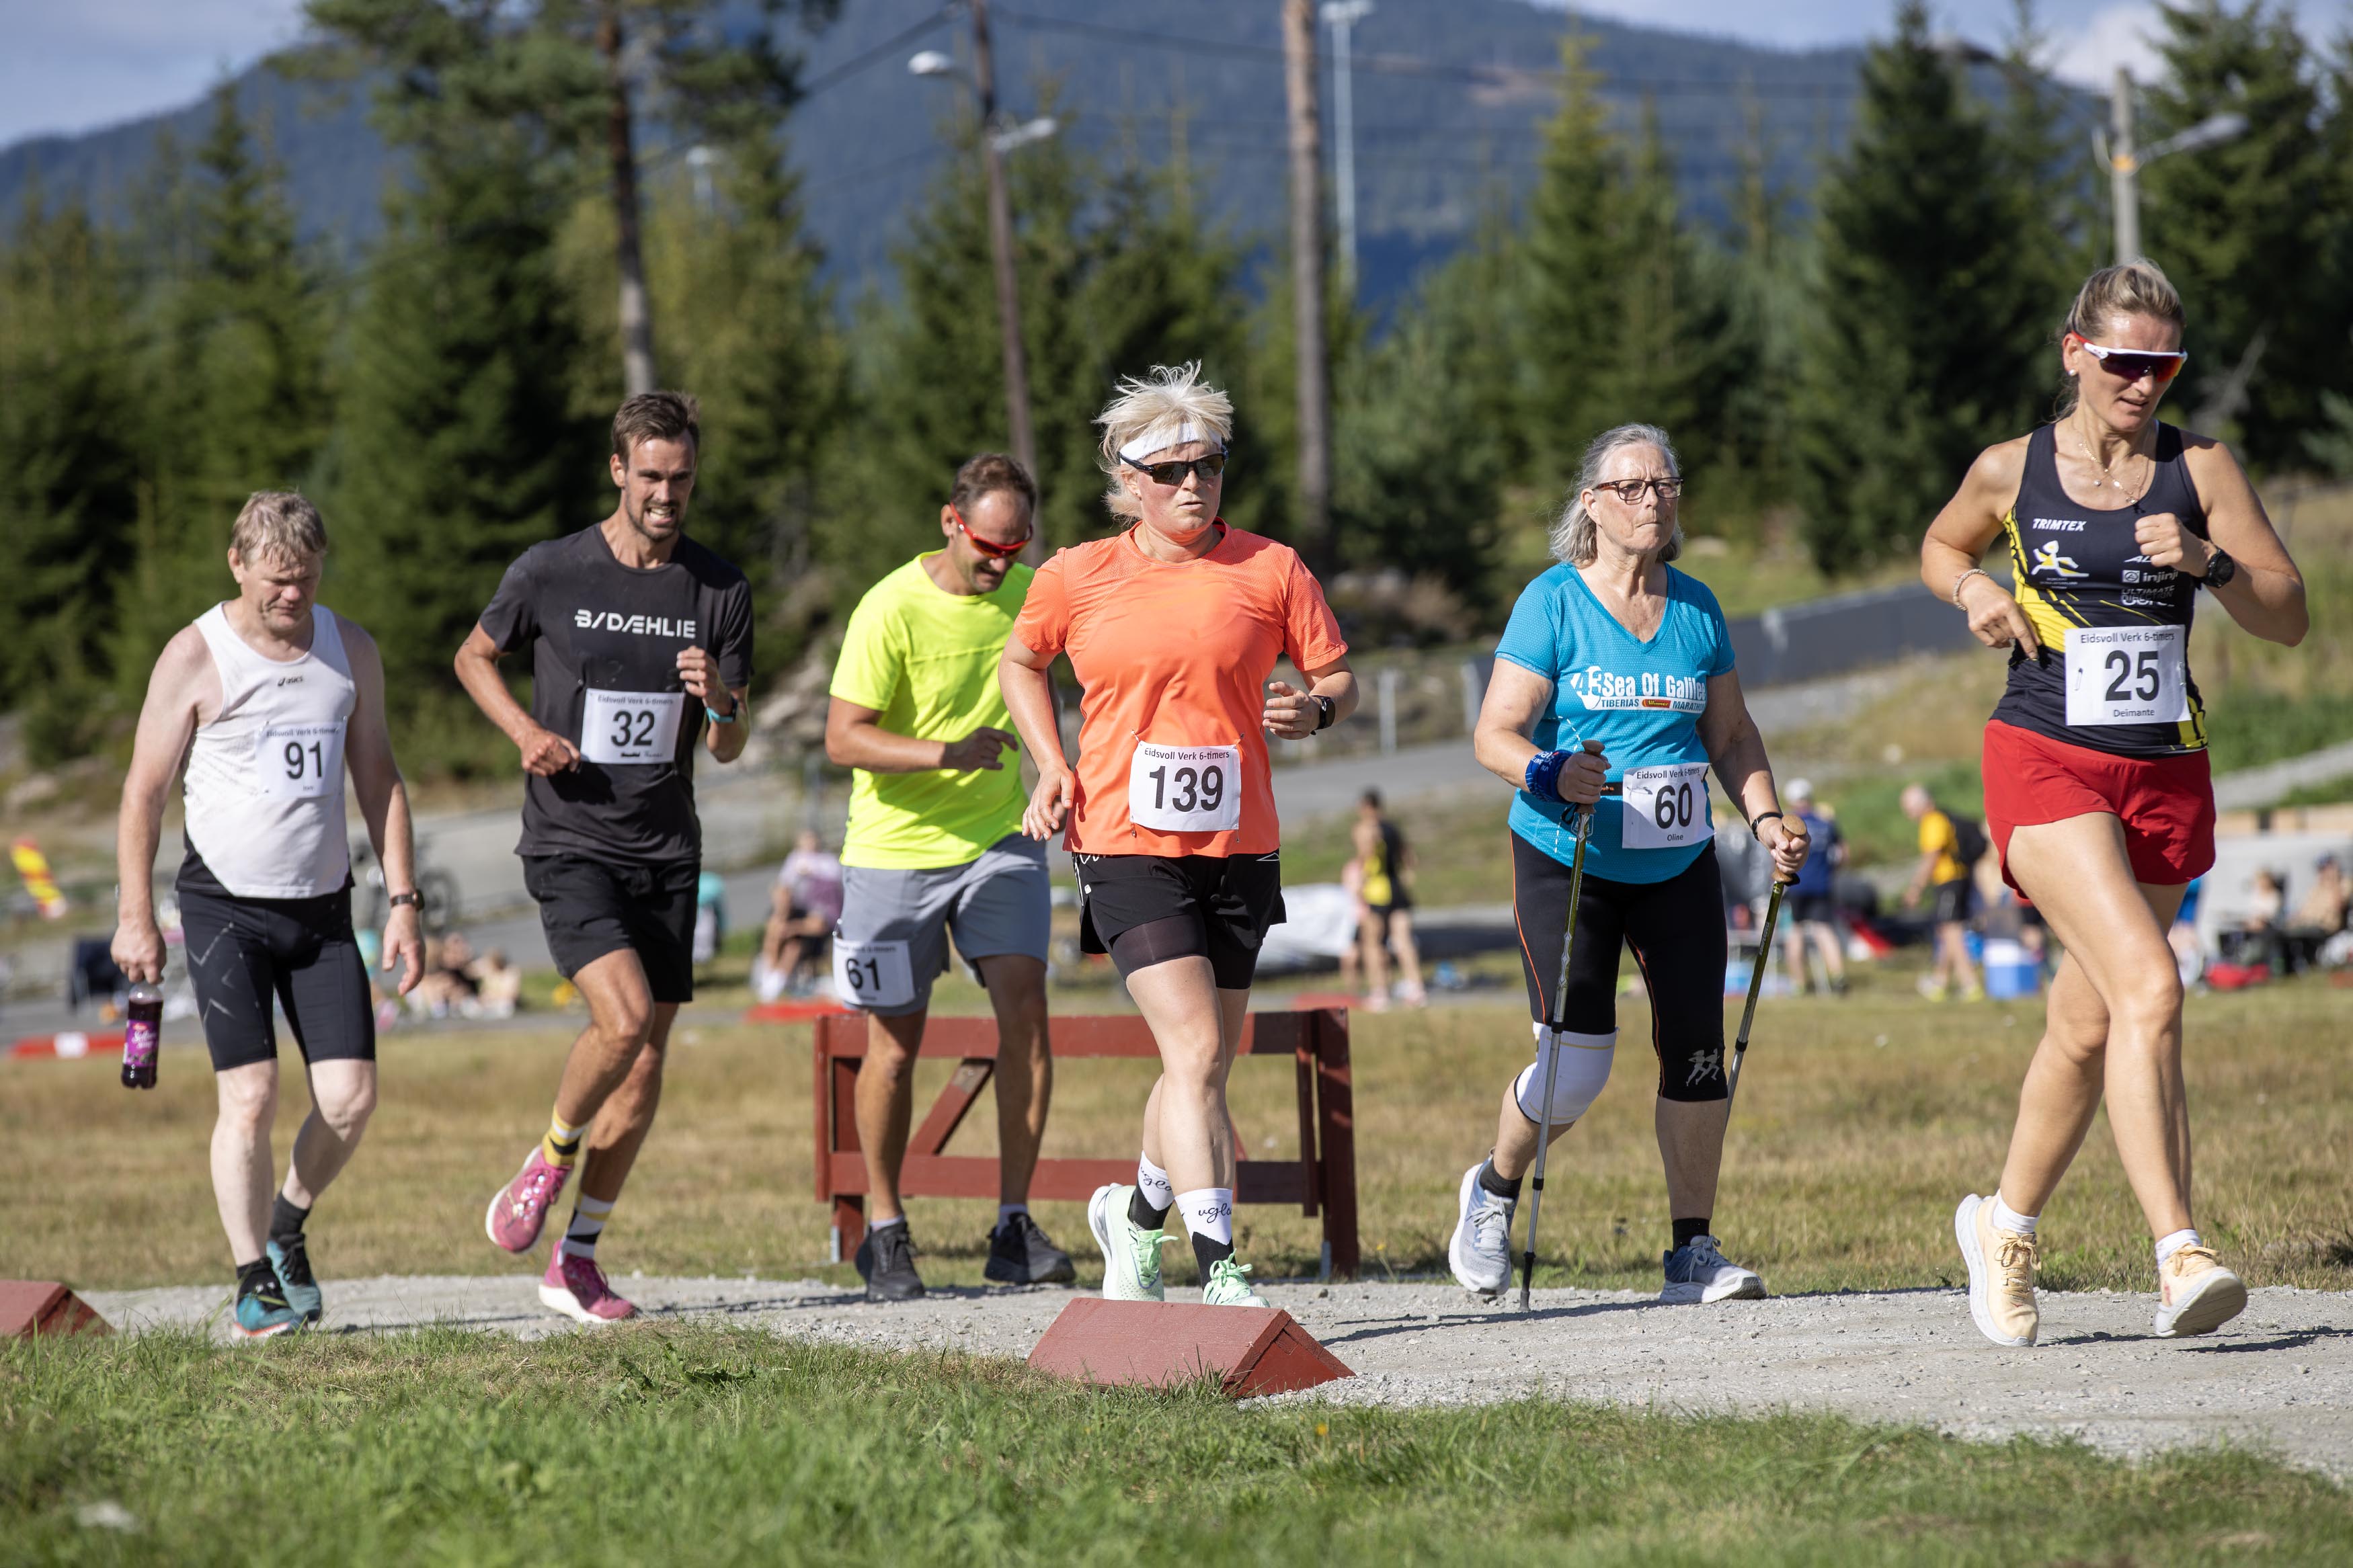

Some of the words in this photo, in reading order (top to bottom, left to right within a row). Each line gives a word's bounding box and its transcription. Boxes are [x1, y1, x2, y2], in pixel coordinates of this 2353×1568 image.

[2032, 518, 2087, 532] TRIMTEX
[2143, 569, 2178, 583] injinji
[2081, 632, 2118, 643] Eidsvoll
[2120, 632, 2142, 642] Verk
[2145, 632, 2175, 641] 6-timers
[1602, 672, 1636, 697] Sea
[1642, 672, 1659, 696] Of
[1666, 675, 1706, 700] Galilee
[2105, 650, 2160, 701] 25
[1601, 699, 1640, 707] TIBERIAS
[2114, 708, 2155, 717] Deimante
[611, 710, 655, 747] 32
[284, 741, 322, 780] 91
[1144, 747, 1175, 759] Eidsvoll
[1199, 751, 1230, 760] 6-timers
[1637, 770, 1667, 779] Eidsvoll
[1669, 769, 1683, 778] Verk
[1684, 768, 1700, 776] 6-timers
[1149, 765, 1224, 812] 139
[1655, 782, 1692, 829] 60
[846, 958, 881, 991] 61
